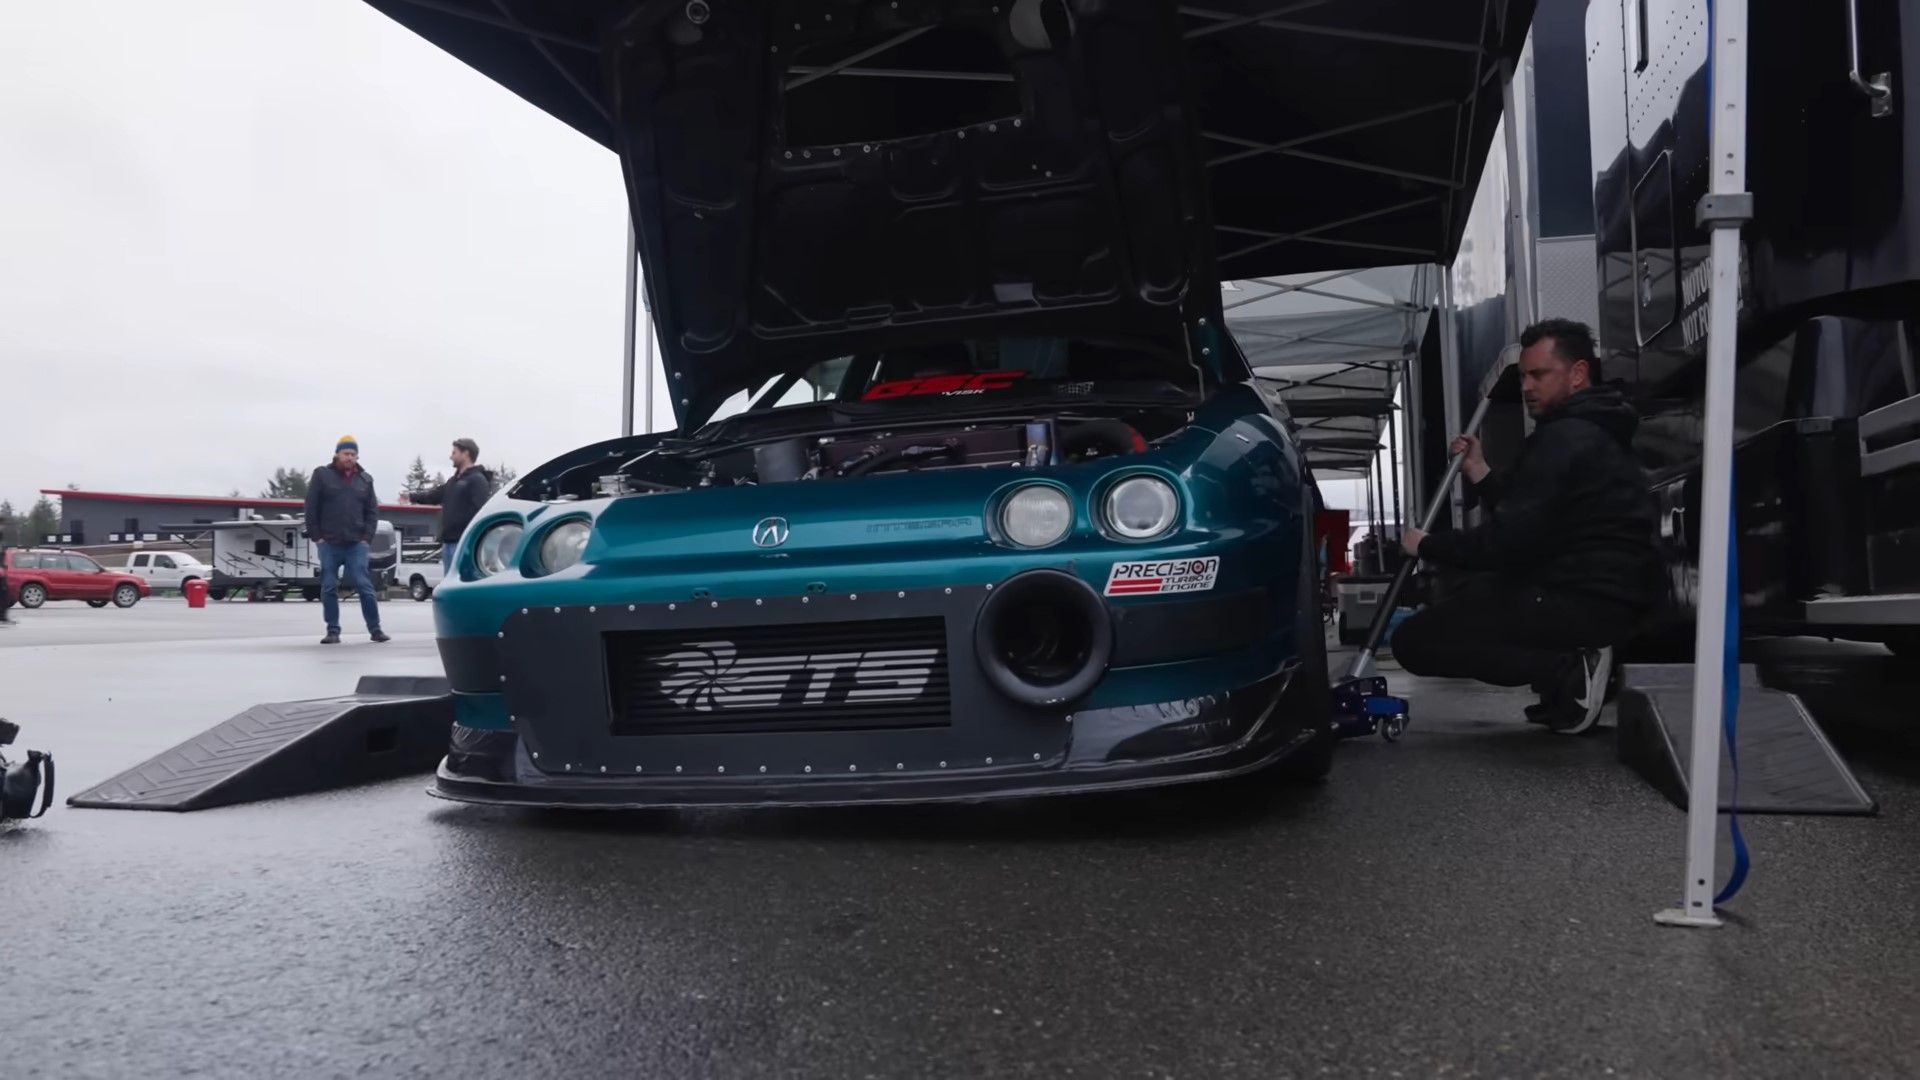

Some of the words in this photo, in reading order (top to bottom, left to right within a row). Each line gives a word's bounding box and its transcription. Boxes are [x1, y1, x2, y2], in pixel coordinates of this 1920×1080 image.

[1681, 311, 1700, 349] NOT
[1113, 559, 1217, 578] PRECISION
[1161, 581, 1211, 591] ENGINE
[1165, 574, 1204, 584] TURBO
